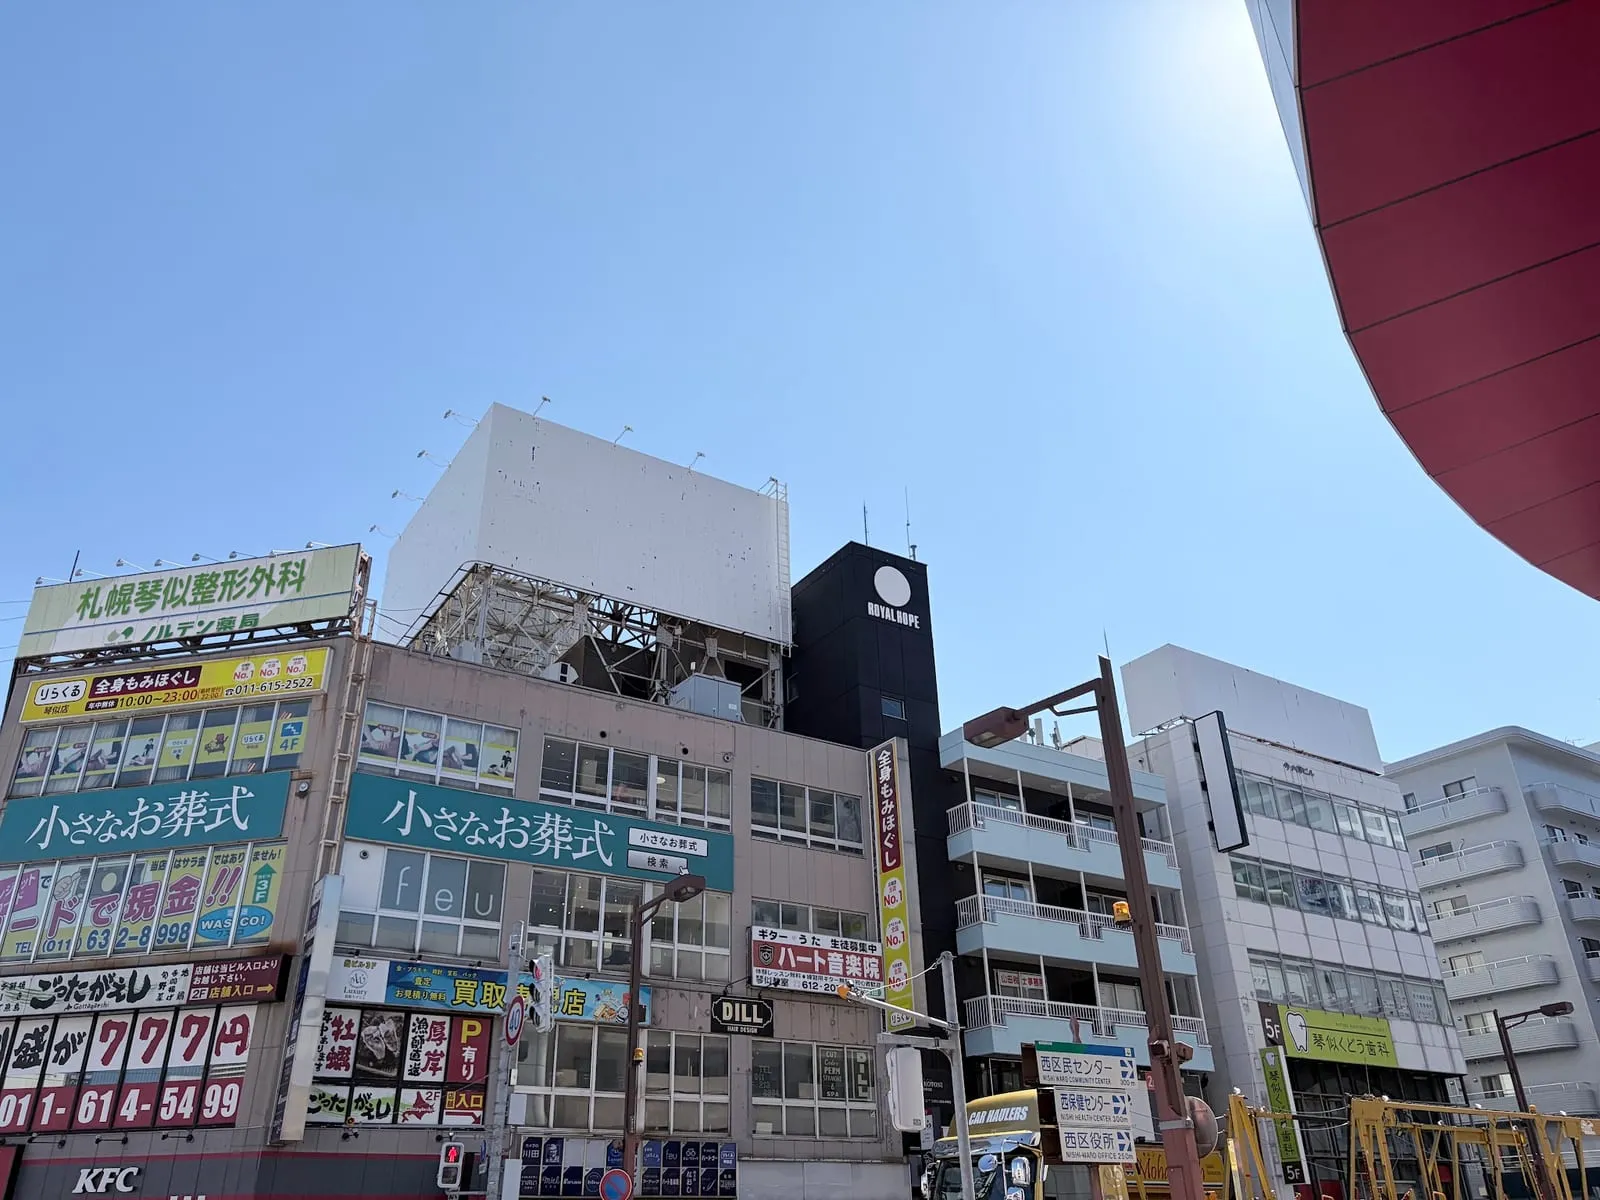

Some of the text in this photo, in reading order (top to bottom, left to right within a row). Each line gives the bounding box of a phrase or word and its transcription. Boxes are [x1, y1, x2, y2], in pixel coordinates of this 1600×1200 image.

[76, 558, 306, 621] 札幌琴似整形外科
[868, 602, 920, 629] ROYAL HOPE
[95, 670, 196, 694] 全身もみほぐし
[235, 678, 313, 694] 011-615-2522
[40, 684, 81, 701] りらくる
[43, 704, 69, 715] 琴似店
[243, 734, 264, 744] りらくる
[280, 737, 299, 751] 4F
[25, 785, 255, 850] 小さなお葬式
[877, 749, 898, 868] 全身もみほぐし
[382, 789, 616, 867] 小さなお葬式
[639, 831, 698, 853] 小さなお葬式
[647, 856, 669, 871] 検索
[0, 865, 243, 940] ードで現金!!
[884, 890, 903, 907] No.1
[201, 915, 265, 930] WASCO!
[16, 941, 33, 954] TEL
[86, 921, 192, 951] 632-8998
[758, 929, 877, 954] ギター うた 生徒募集中
[886, 930, 906, 948] No.1
[194, 959, 278, 976] 店舗は当ビル入口より
[778, 946, 880, 979] ハート音楽院
[30, 970, 151, 1010] ごったがえし
[343, 985, 368, 996] Luxury
[413, 976, 432, 987] 査定
[801, 980, 840, 993] 612-20
[191, 984, 254, 1000] 2F 店舗入口
[395, 988, 446, 1002] お見積り無料
[452, 978, 587, 1017] 買取店
[509, 1007, 521, 1034] 40
[722, 1001, 763, 1024] DILL
[1265, 1018, 1281, 1040] 5F
[407, 1016, 429, 1078] 漁師直送
[420, 1020, 448, 1077] 厚岸
[825, 1050, 837, 1058] CUT
[1312, 1032, 1390, 1058] 琴似くどう歯科
[824, 1067, 841, 1075] PERM
[1040, 1056, 1113, 1075] 西区民センター
[0, 1083, 240, 1128] 011-614-5499
[306, 1091, 392, 1120] ごったがえし
[425, 1091, 441, 1102] 2F
[456, 1090, 484, 1109] 入口
[1060, 1094, 1111, 1111] 西保健センター
[968, 1106, 1029, 1126] CAR HAULERS
[1269, 1070, 1294, 1156] 琴似く歯科
[1064, 1132, 1114, 1150] 西区役所
[522, 1149, 540, 1159] 川田
[1065, 1151, 1097, 1159] NISHI-WARD
[1097, 1152, 1117, 1160] OFFICE
[72, 1166, 139, 1194] KFC
[1286, 1164, 1301, 1181] 5F
